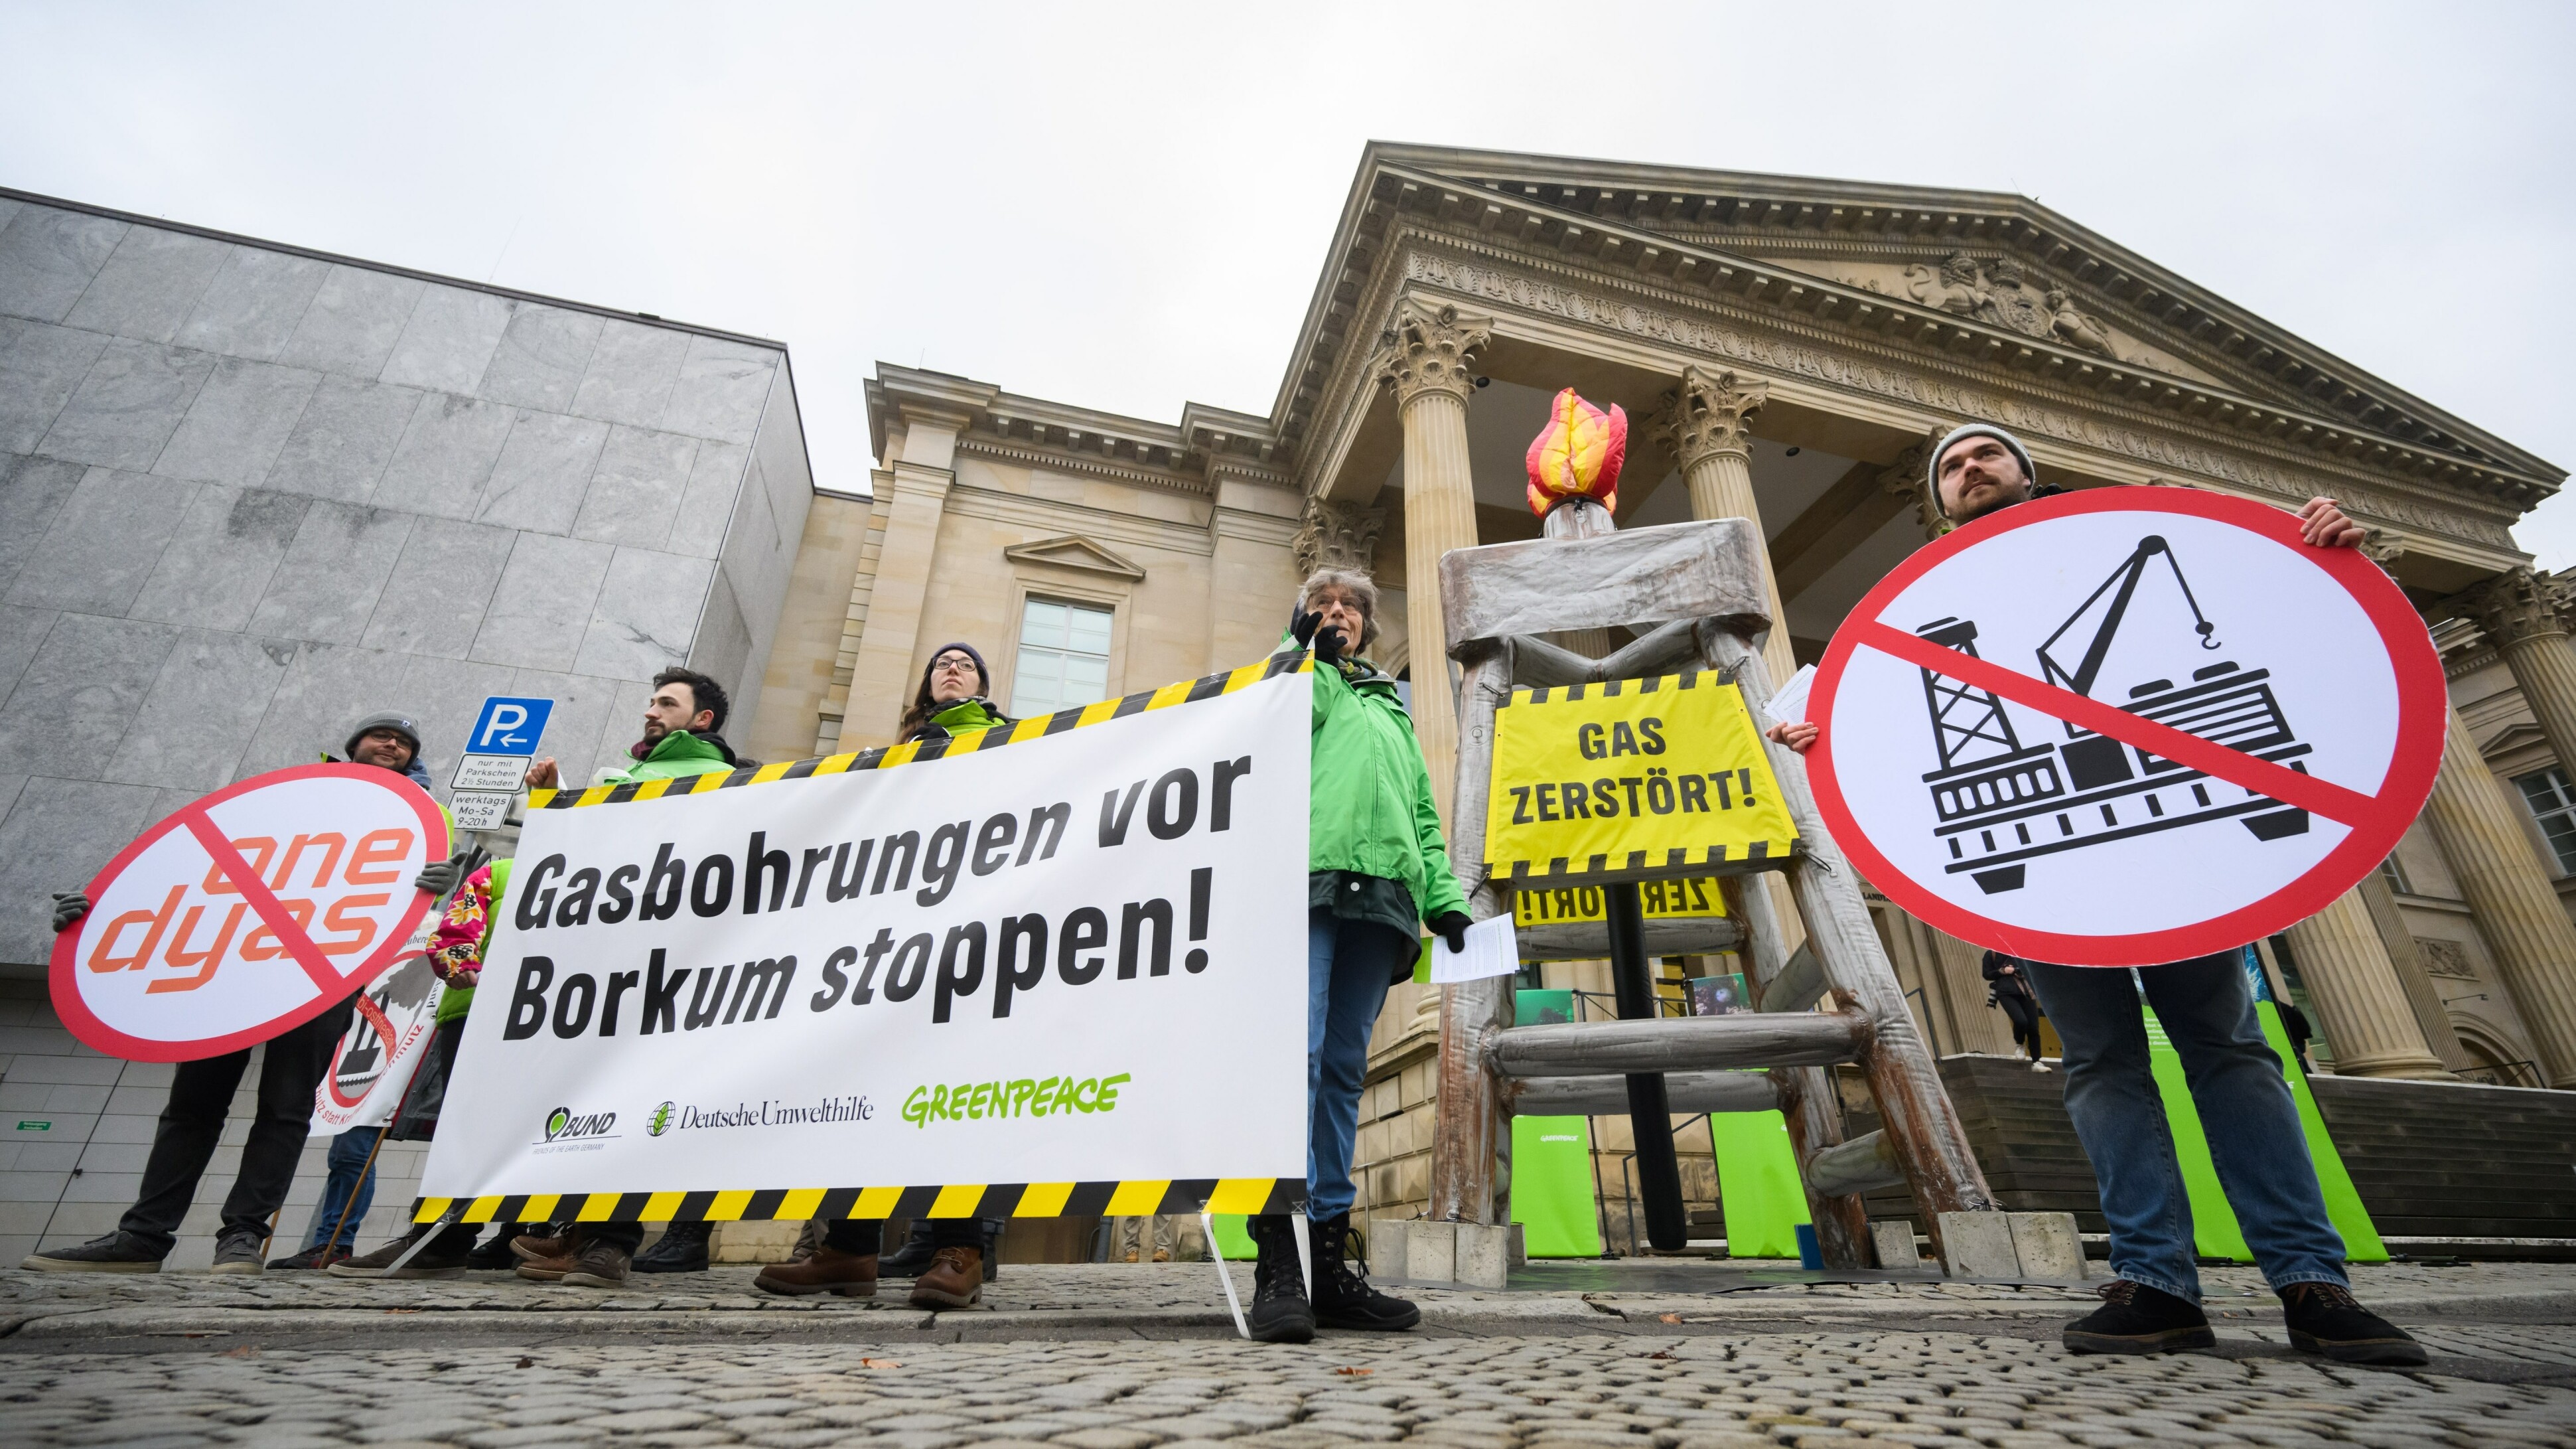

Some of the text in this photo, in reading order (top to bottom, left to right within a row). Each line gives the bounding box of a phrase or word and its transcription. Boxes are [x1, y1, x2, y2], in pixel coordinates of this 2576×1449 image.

[480, 704, 528, 746] P
[1579, 718, 1667, 760] GAS
[466, 768, 516, 777] Parkschein
[456, 797, 506, 806] werktags
[458, 806, 494, 816] Mo-Sa
[1510, 767, 1756, 825] ZERSTÖRT!
[458, 817, 488, 826] 9-20 h
[202, 828, 415, 895] one
[516, 755, 1252, 931] Gasbohrungen vor
[88, 884, 392, 994] dyas
[502, 867, 1212, 1041] Borkum stoppen!
[680, 1096, 873, 1129] Deutsche Umwelthilfe
[902, 1073, 1131, 1129] GREENPEACE
[561, 1112, 616, 1138] BUND
[580, 1143, 605, 1152] GERMANY
